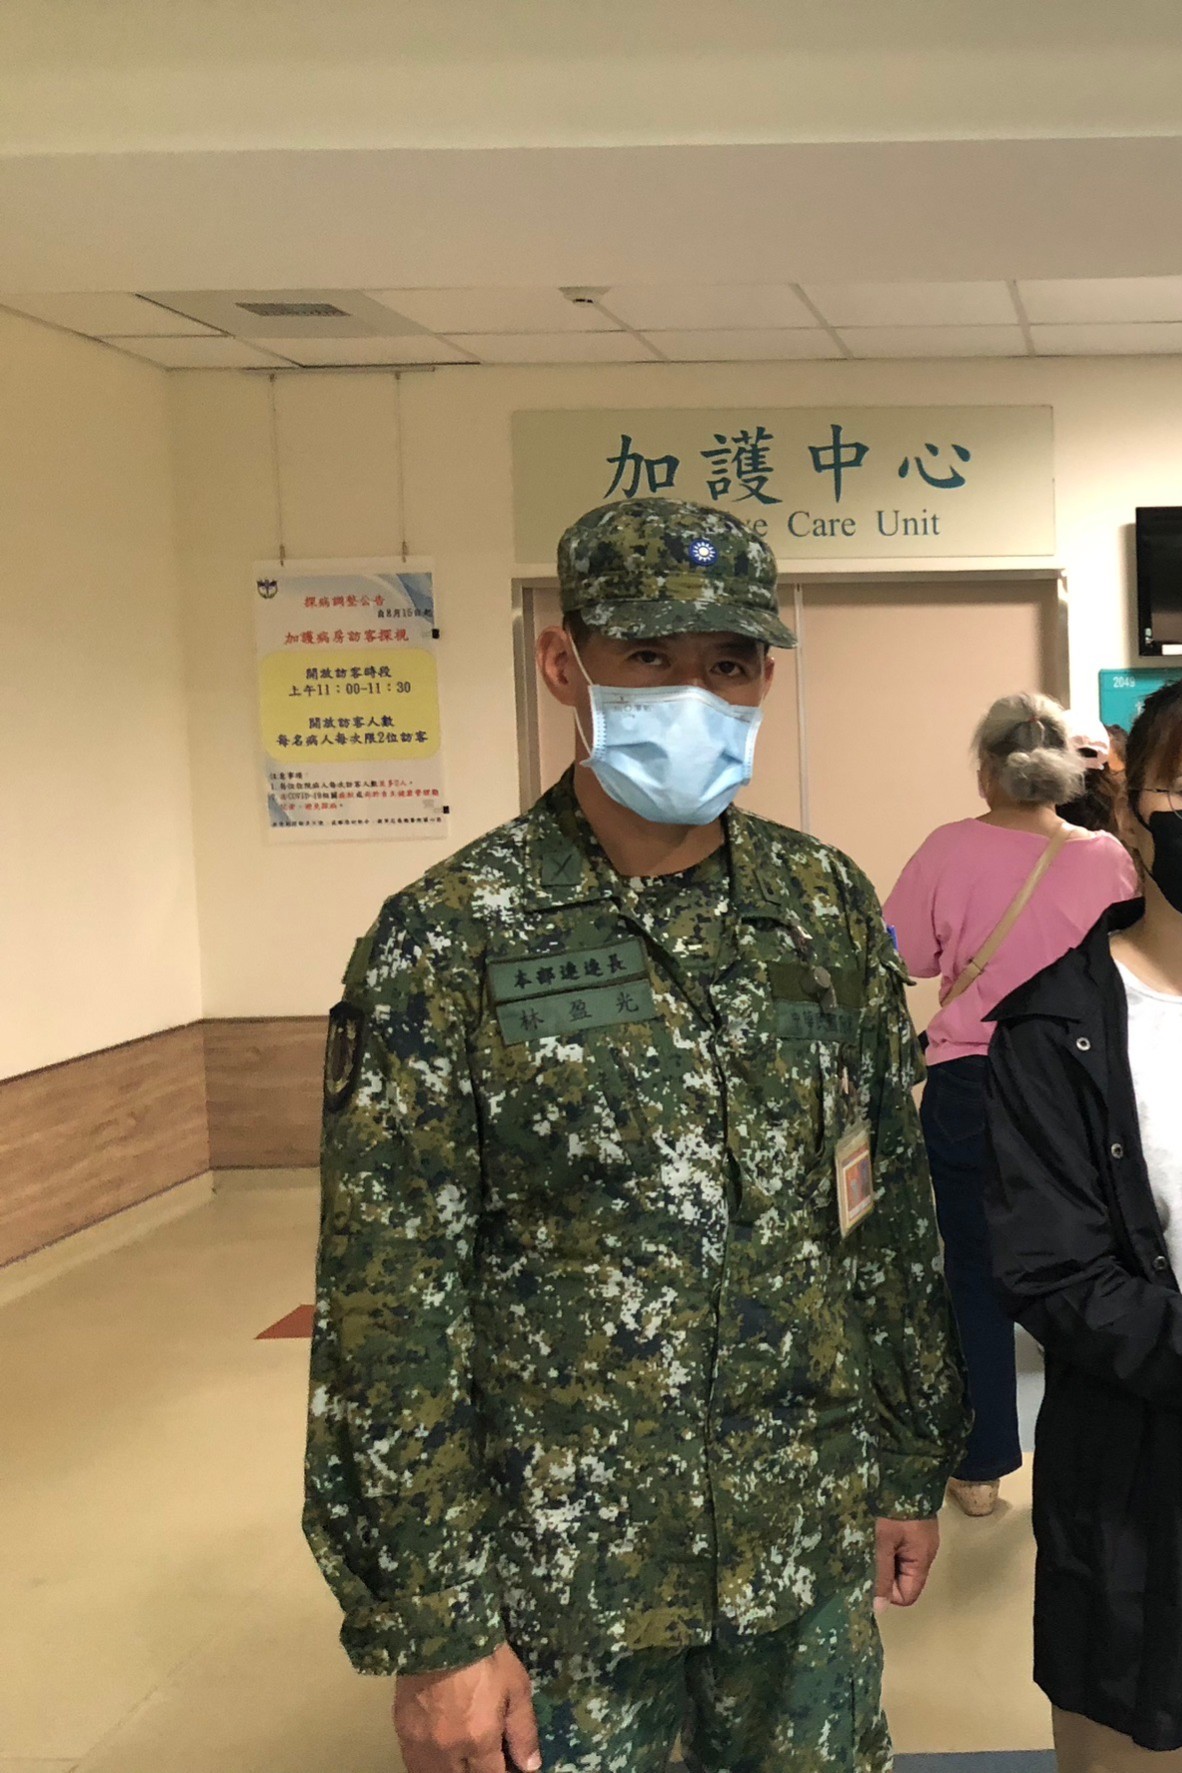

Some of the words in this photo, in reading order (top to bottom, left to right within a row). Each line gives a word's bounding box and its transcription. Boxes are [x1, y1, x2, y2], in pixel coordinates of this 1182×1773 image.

[602, 424, 972, 505] 加護中心
[787, 511, 856, 537] Care
[877, 509, 940, 536] Unit
[304, 595, 386, 609] 探病調整公告
[284, 629, 409, 645] 加護病房訪客探視
[306, 666, 392, 680] 開放訪客時段
[309, 715, 395, 729] 開放訪客人數
[276, 731, 428, 748] 每名病人每次限2位訪客
[520, 991, 640, 1031] 林盈光
